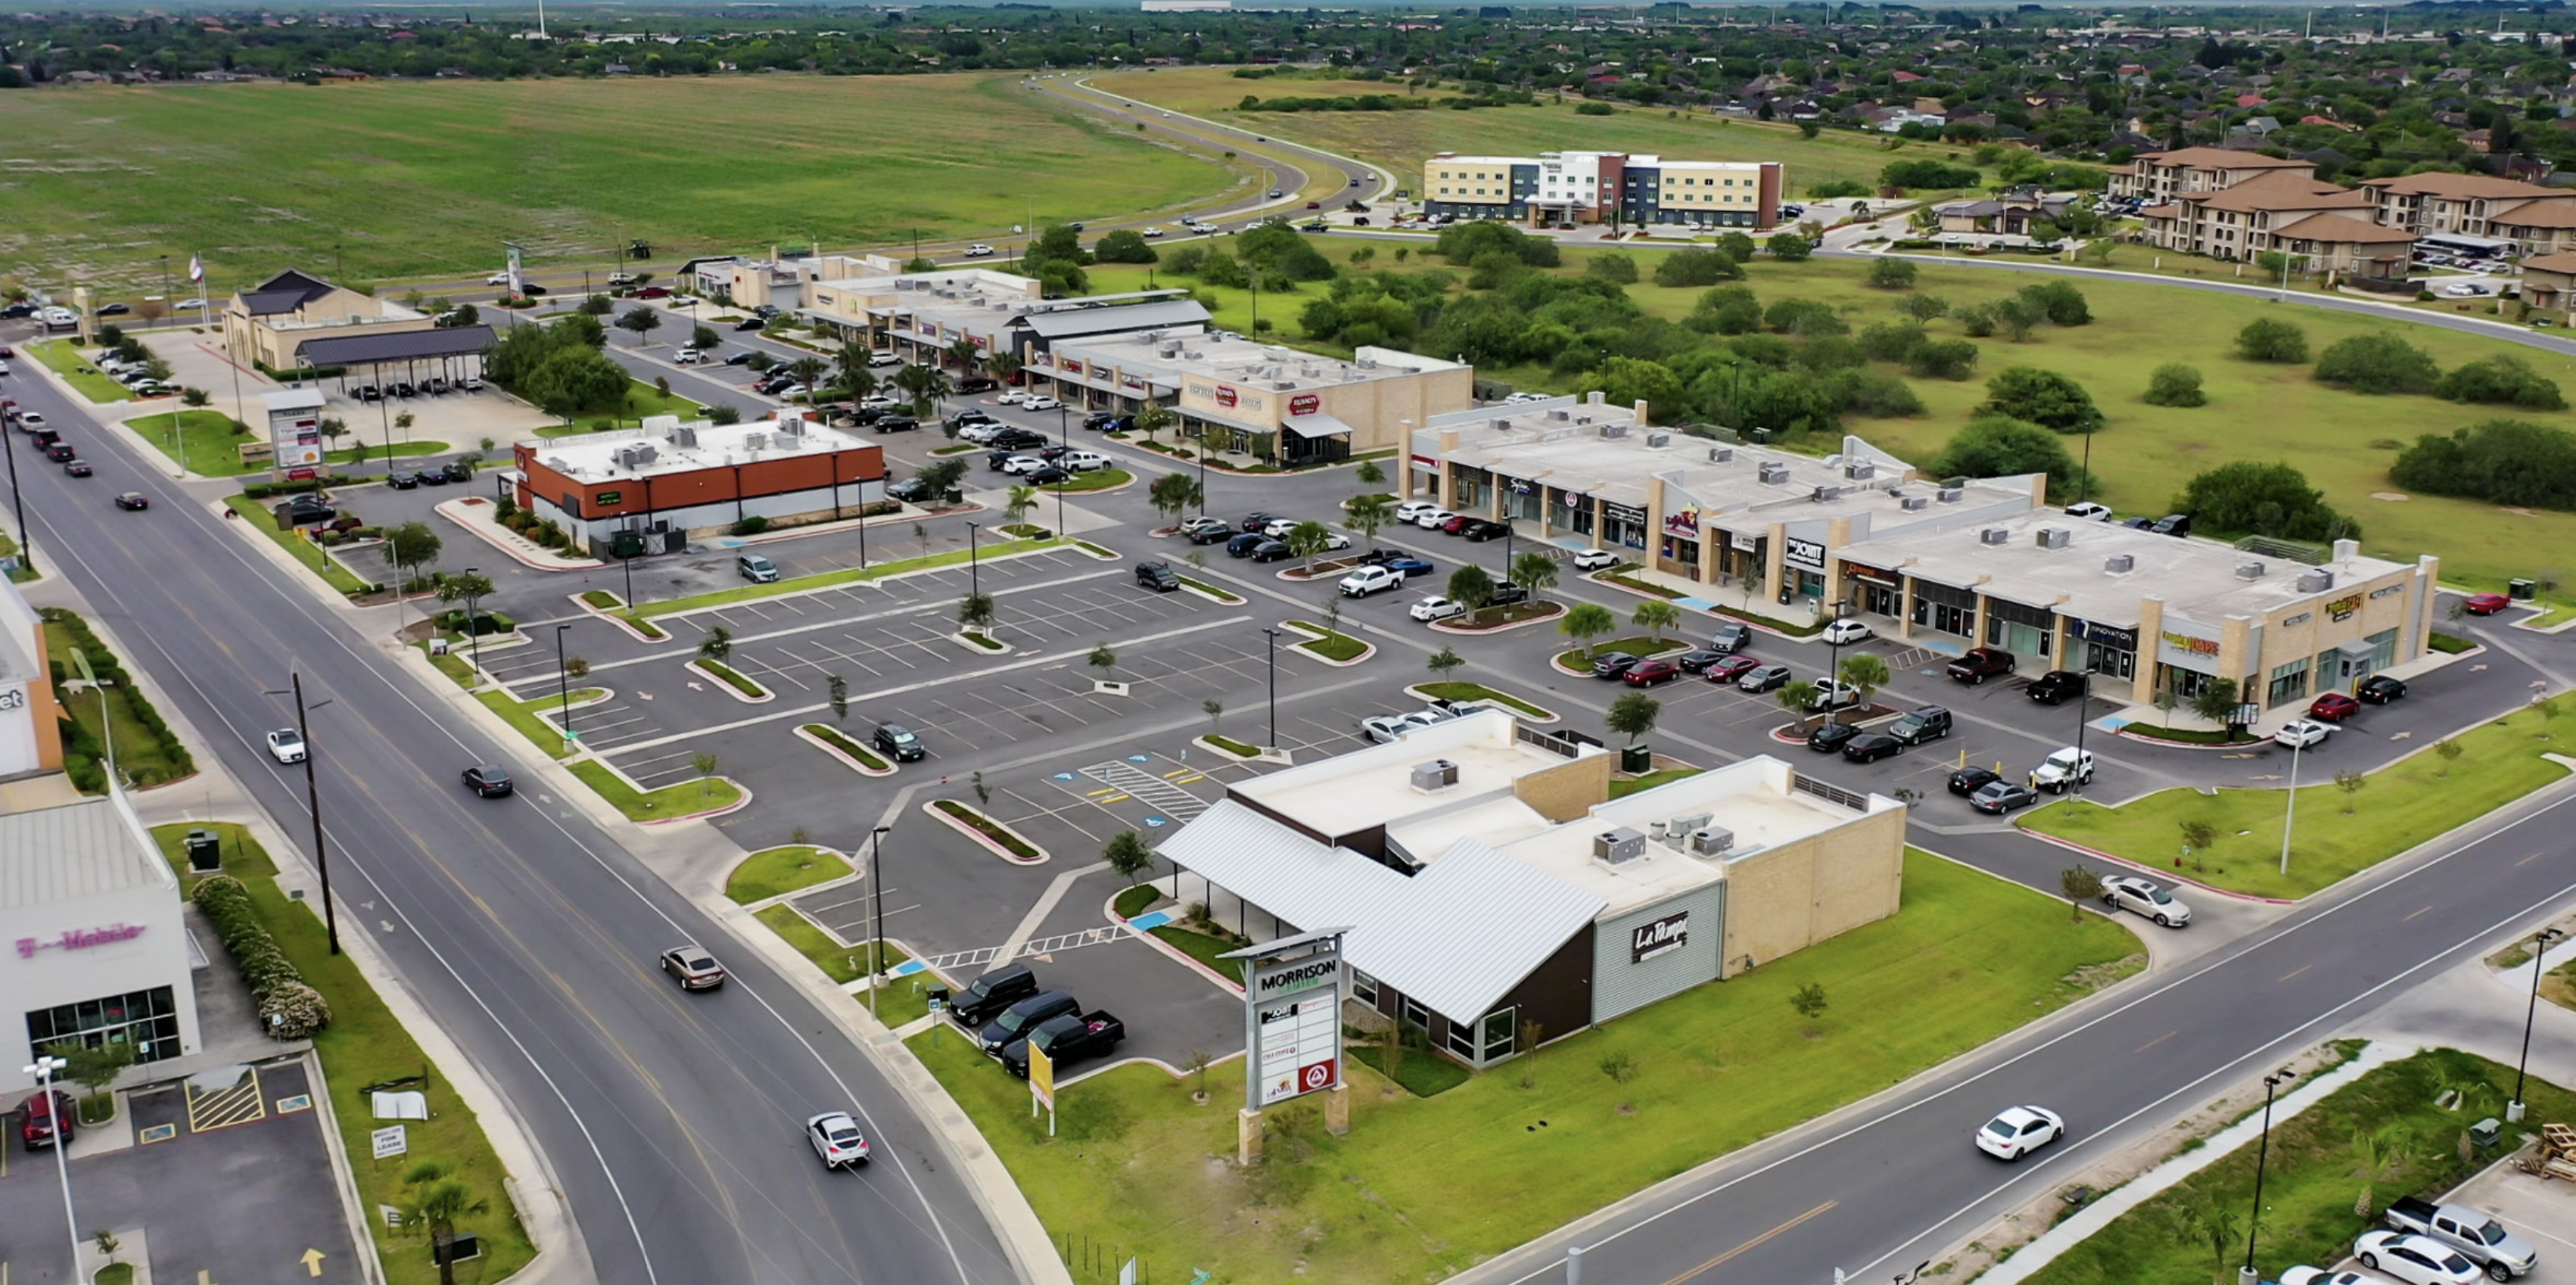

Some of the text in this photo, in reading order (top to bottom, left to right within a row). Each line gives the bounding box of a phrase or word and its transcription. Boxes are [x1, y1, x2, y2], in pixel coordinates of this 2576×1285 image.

[1795, 541, 1823, 559] JOINT
[2089, 625, 2133, 641] INNOVATION
[1635, 918, 1688, 950] La Pampa
[1261, 959, 1336, 991] MORRISON
[377, 1140, 402, 1151] LEASE
